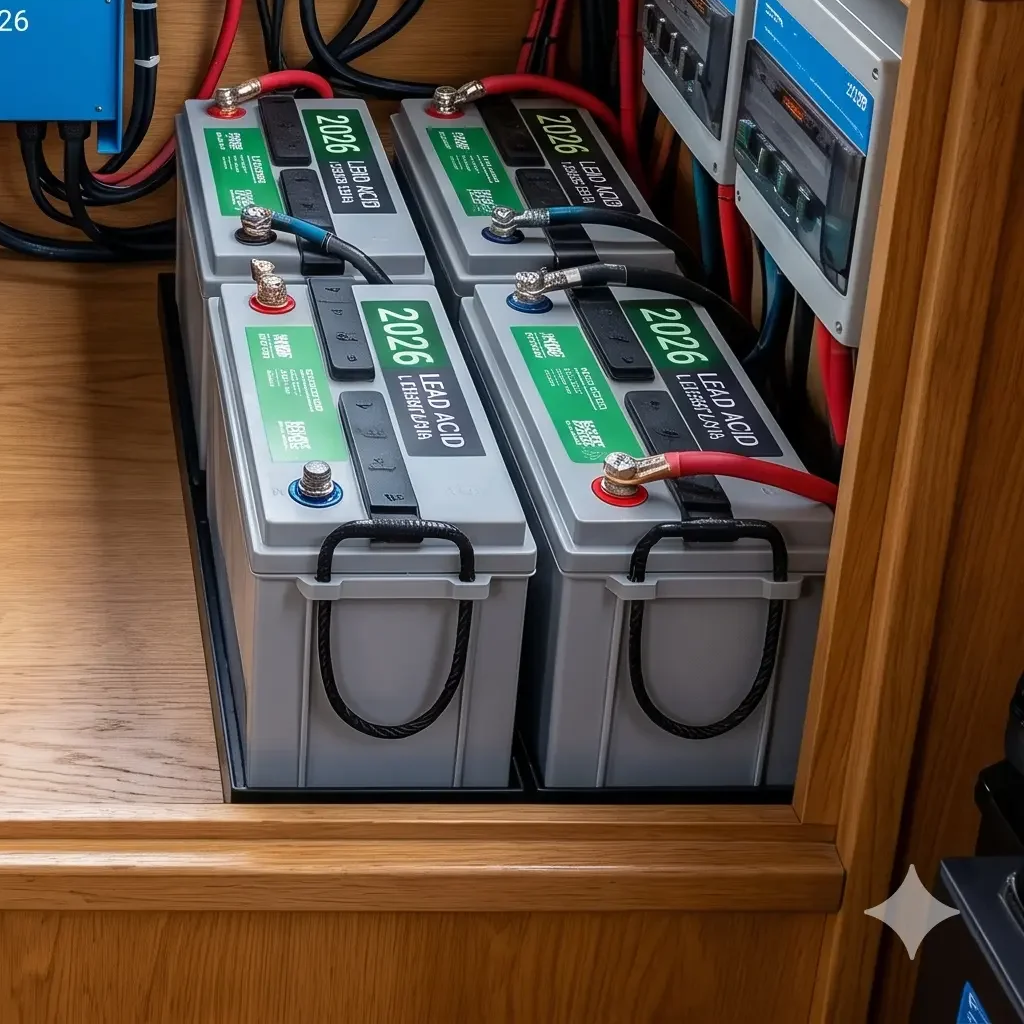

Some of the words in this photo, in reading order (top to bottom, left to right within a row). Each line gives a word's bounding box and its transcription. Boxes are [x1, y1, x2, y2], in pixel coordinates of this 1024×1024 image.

[316, 115, 361, 154] 2026
[536, 114, 589, 154] 2026
[377, 307, 434, 365] 2026
[639, 308, 709, 365] 2026
[419, 373, 451, 409] LEAD
[697, 372, 735, 408] LEAD
[721, 410, 759, 447] ACID
[434, 412, 465, 448] ACID
